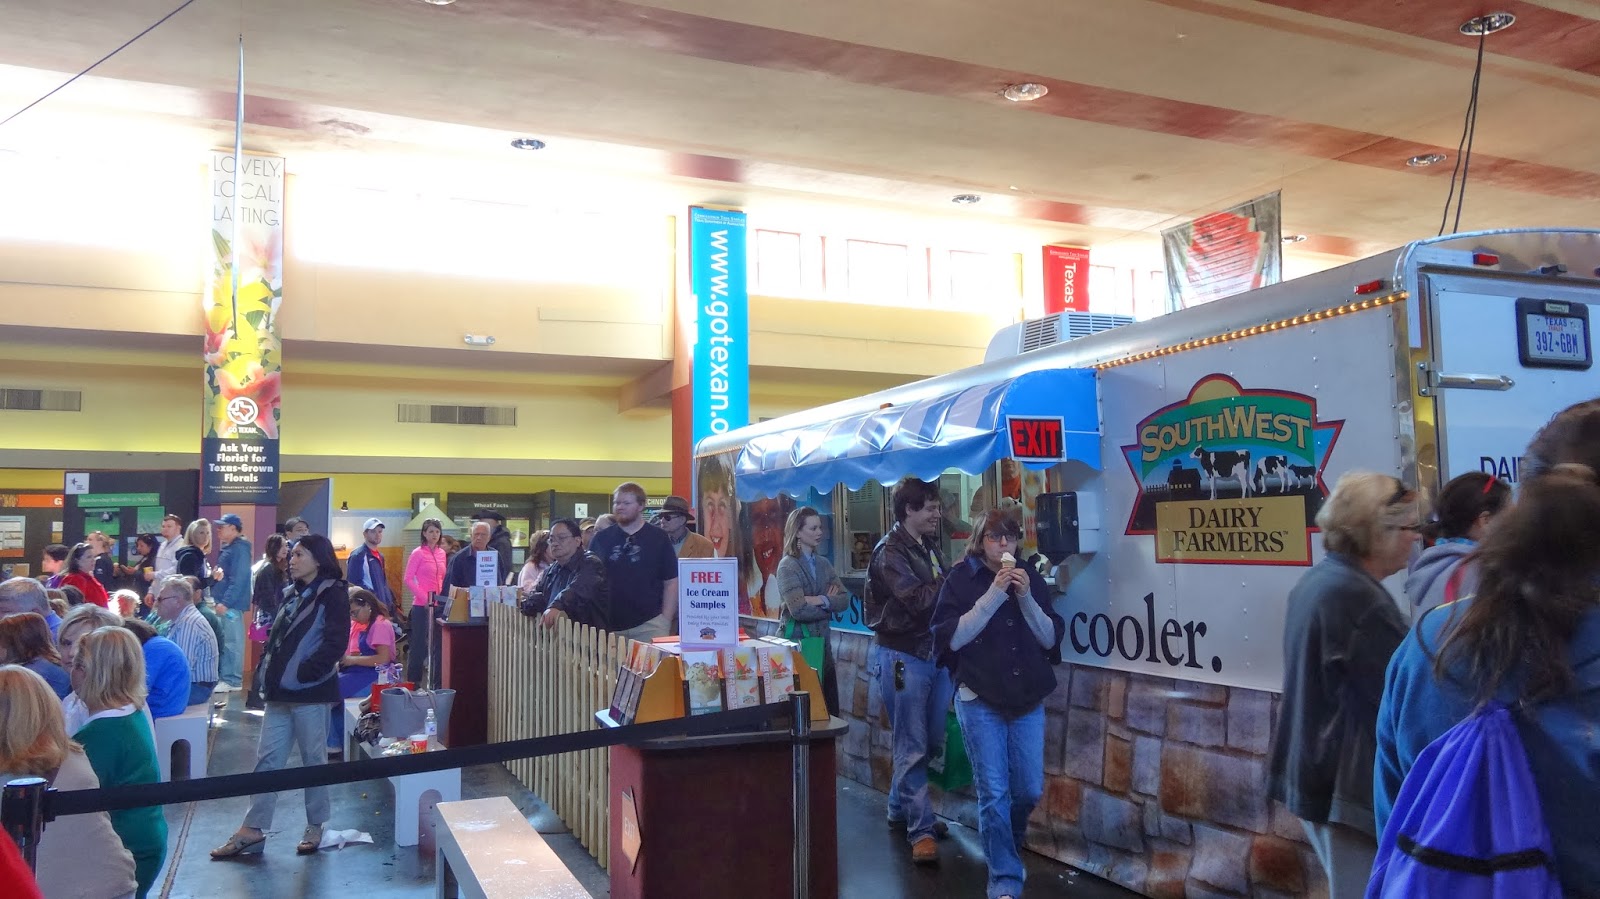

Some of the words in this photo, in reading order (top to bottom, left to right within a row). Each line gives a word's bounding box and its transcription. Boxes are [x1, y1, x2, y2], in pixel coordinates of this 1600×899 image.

[214, 205, 280, 226] LATING.
[1064, 262, 1077, 304] Texas
[1544, 317, 1567, 327] TEXAS
[704, 229, 734, 434] www.gotexan.o
[227, 426, 237, 434] GO
[1011, 420, 1060, 456] EXIT
[219, 443, 239, 452] Ask
[241, 443, 264, 453] Your
[216, 453, 249, 463] Florist
[251, 453, 267, 463] for
[209, 463, 274, 473] Texas-Grown
[1480, 456, 1524, 483] DAI
[224, 473, 259, 482] Florals
[1188, 506, 1264, 529] DAIRY
[691, 571, 723, 584] FREE
[686, 588, 699, 597] Ice
[701, 588, 730, 597] Cream
[690, 600, 726, 610] Samples
[1070, 592, 1222, 673] cooler.
